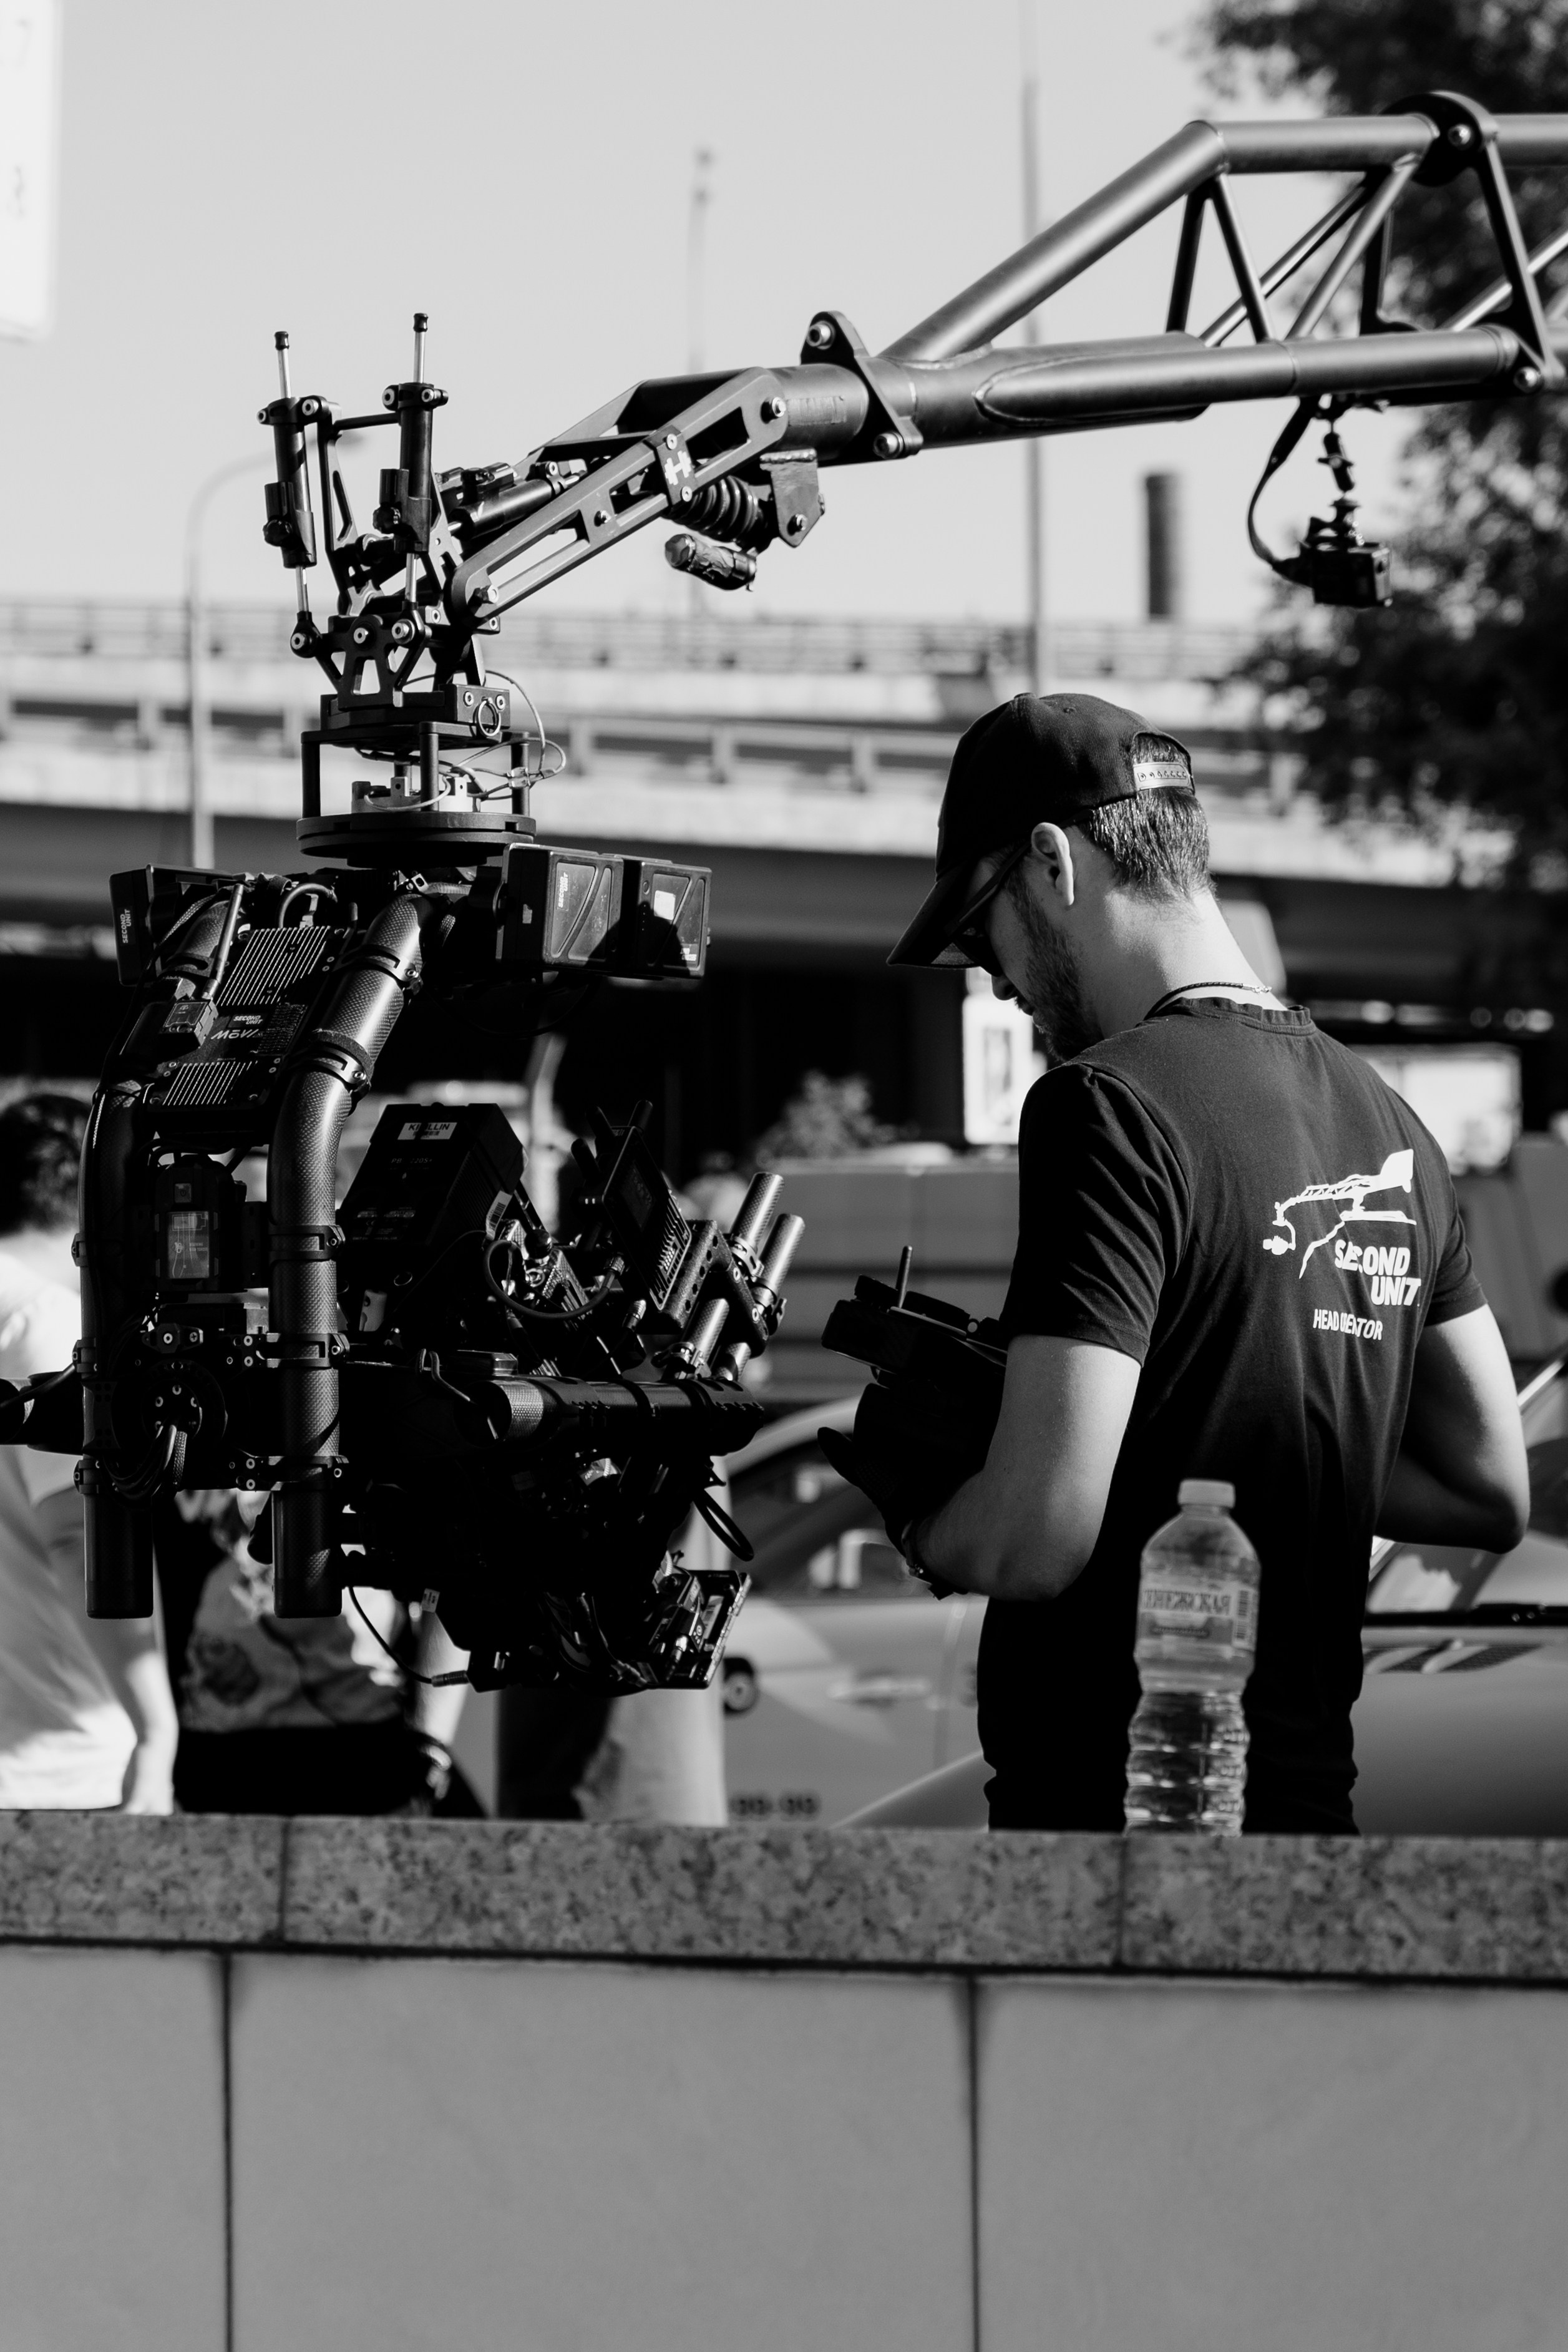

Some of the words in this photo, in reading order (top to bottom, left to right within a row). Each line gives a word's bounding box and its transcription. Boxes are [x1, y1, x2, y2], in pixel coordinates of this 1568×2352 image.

[120, 914, 129, 944] SECOND
[124, 909, 132, 927] UNIT
[1371, 1276, 1422, 1306] UNIT
[1312, 1308, 1340, 1332] HEAD
